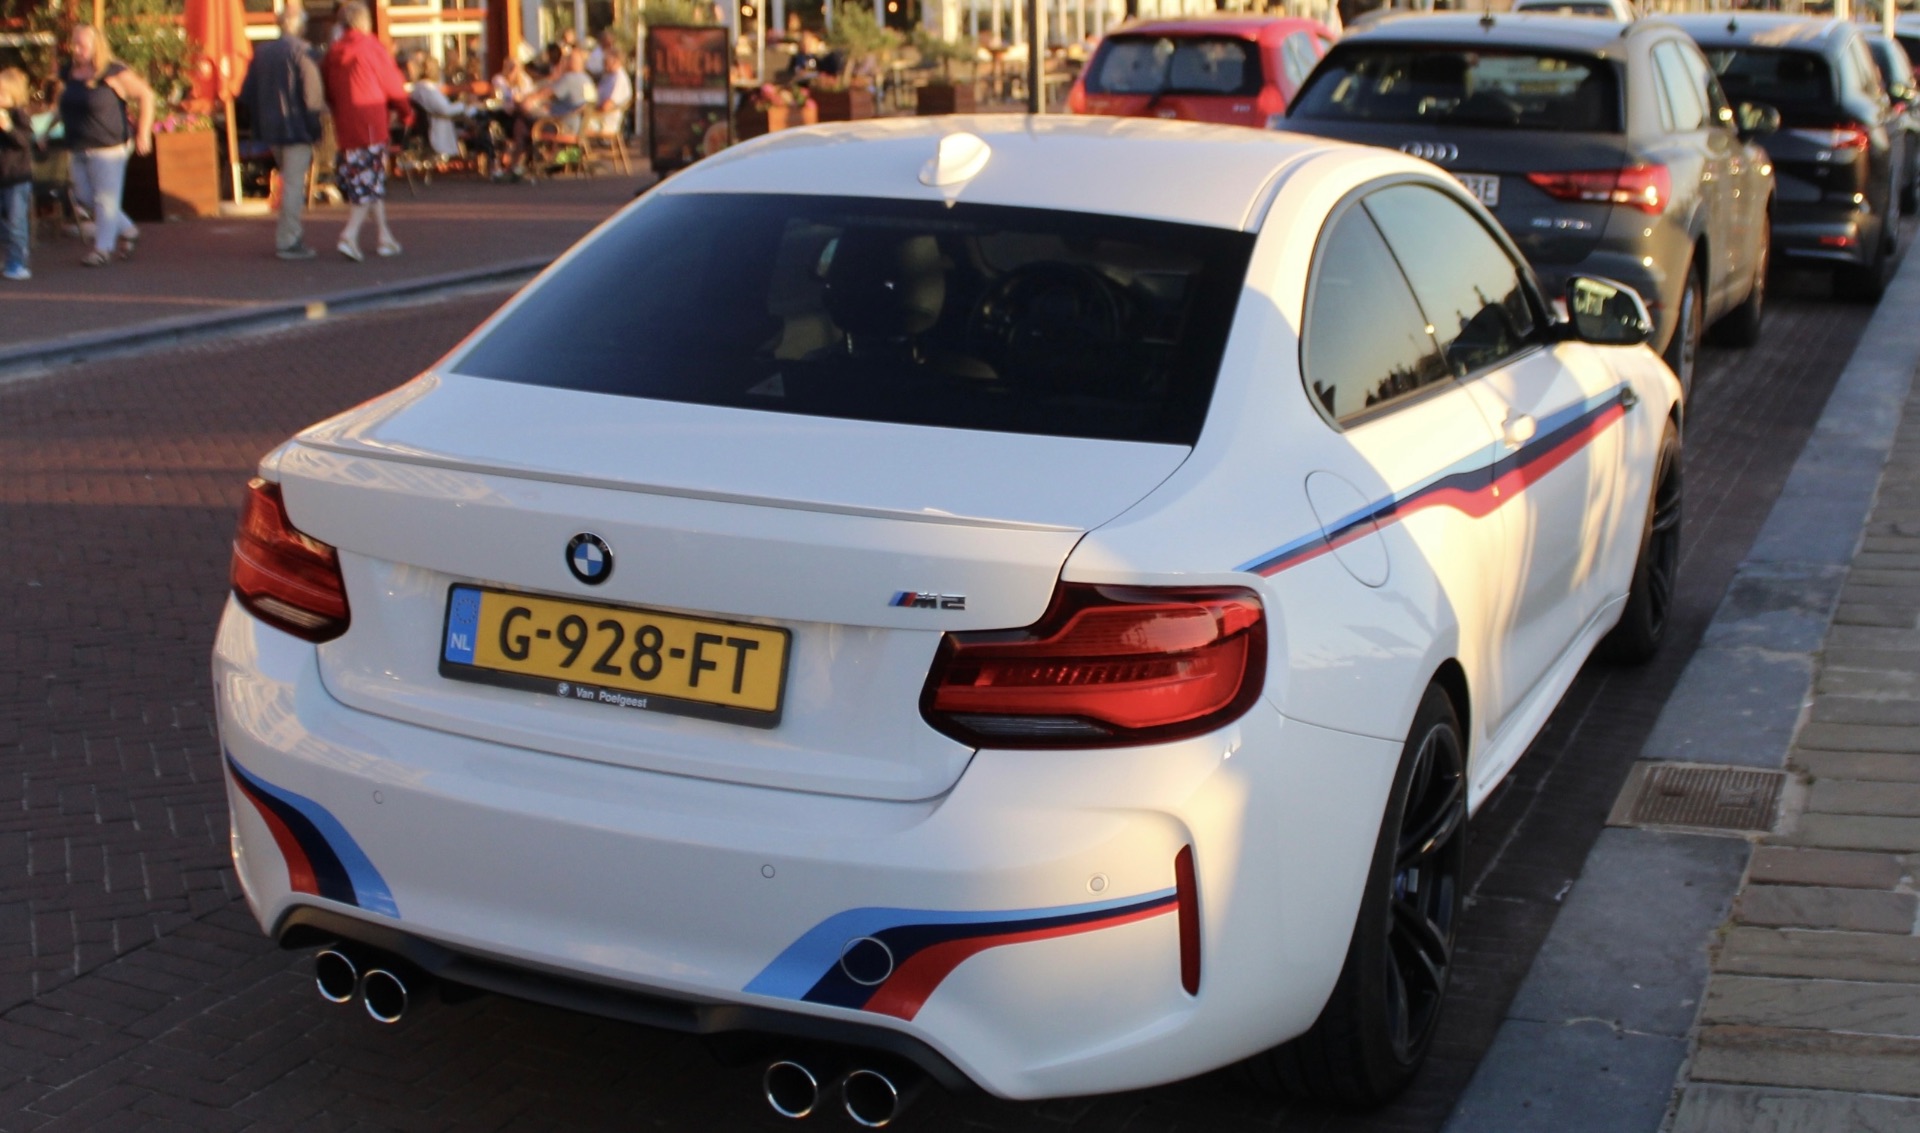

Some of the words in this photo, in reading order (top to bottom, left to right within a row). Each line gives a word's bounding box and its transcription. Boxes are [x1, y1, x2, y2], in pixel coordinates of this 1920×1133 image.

[909, 591, 965, 610] M2
[450, 633, 471, 651] NL
[499, 607, 759, 694] G-928-FT
[576, 687, 595, 700] Van
[599, 690, 648, 708] Poelgeest
